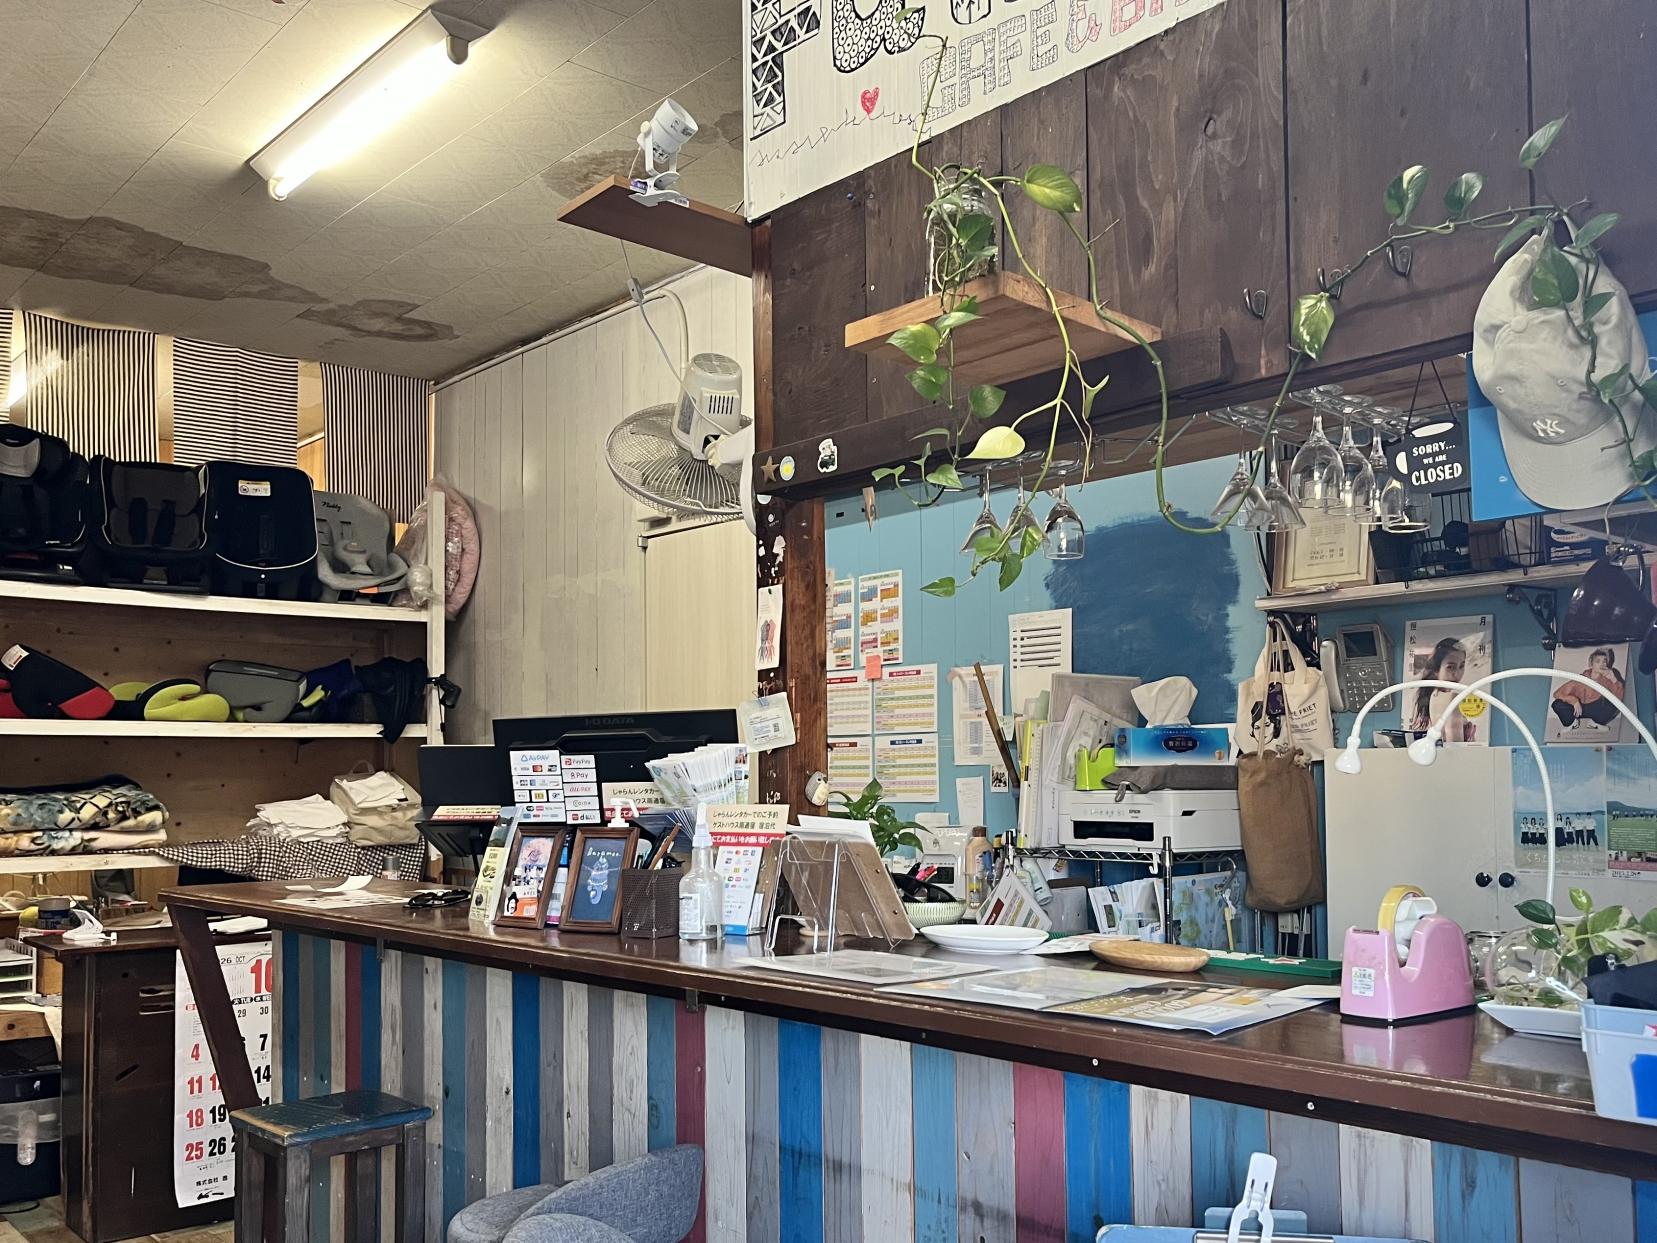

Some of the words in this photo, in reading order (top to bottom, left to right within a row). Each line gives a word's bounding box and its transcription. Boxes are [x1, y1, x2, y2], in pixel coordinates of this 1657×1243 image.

[1532, 418, 1566, 437] NY
[1412, 441, 1456, 457] SORRY...
[1422, 456, 1434, 465] WE
[1434, 453, 1447, 463] ARE
[1411, 462, 1463, 486] CLOSED
[237, 1008, 247, 1018] 29
[259, 1006, 269, 1015] 30
[190, 1043, 200, 1061] 4
[259, 1033, 268, 1051] 7
[187, 1075, 203, 1095] 11
[254, 1064, 271, 1083] 14
[186, 1108, 204, 1128] 18
[209, 1104, 227, 1124] 19
[185, 1141, 204, 1161] 25
[208, 1136, 227, 1157] 26
